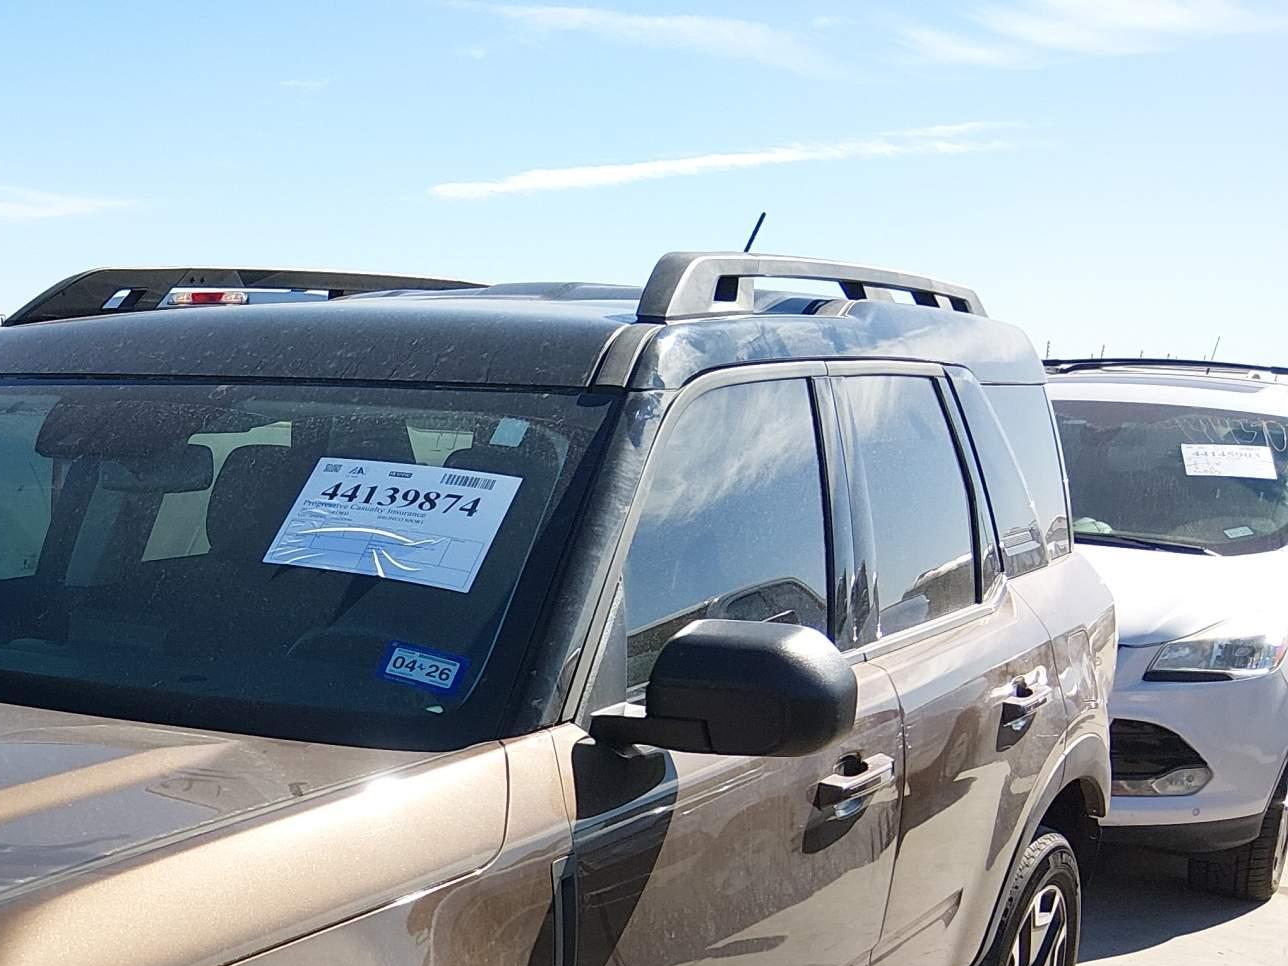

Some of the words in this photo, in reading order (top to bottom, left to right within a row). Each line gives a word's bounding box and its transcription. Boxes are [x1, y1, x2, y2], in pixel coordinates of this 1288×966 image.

[320, 481, 481, 517] 44139874
[350, 504, 386, 514] Casualty
[387, 508, 426, 518] Insurance
[392, 656, 417, 672] 04
[425, 664, 452, 681] 26
